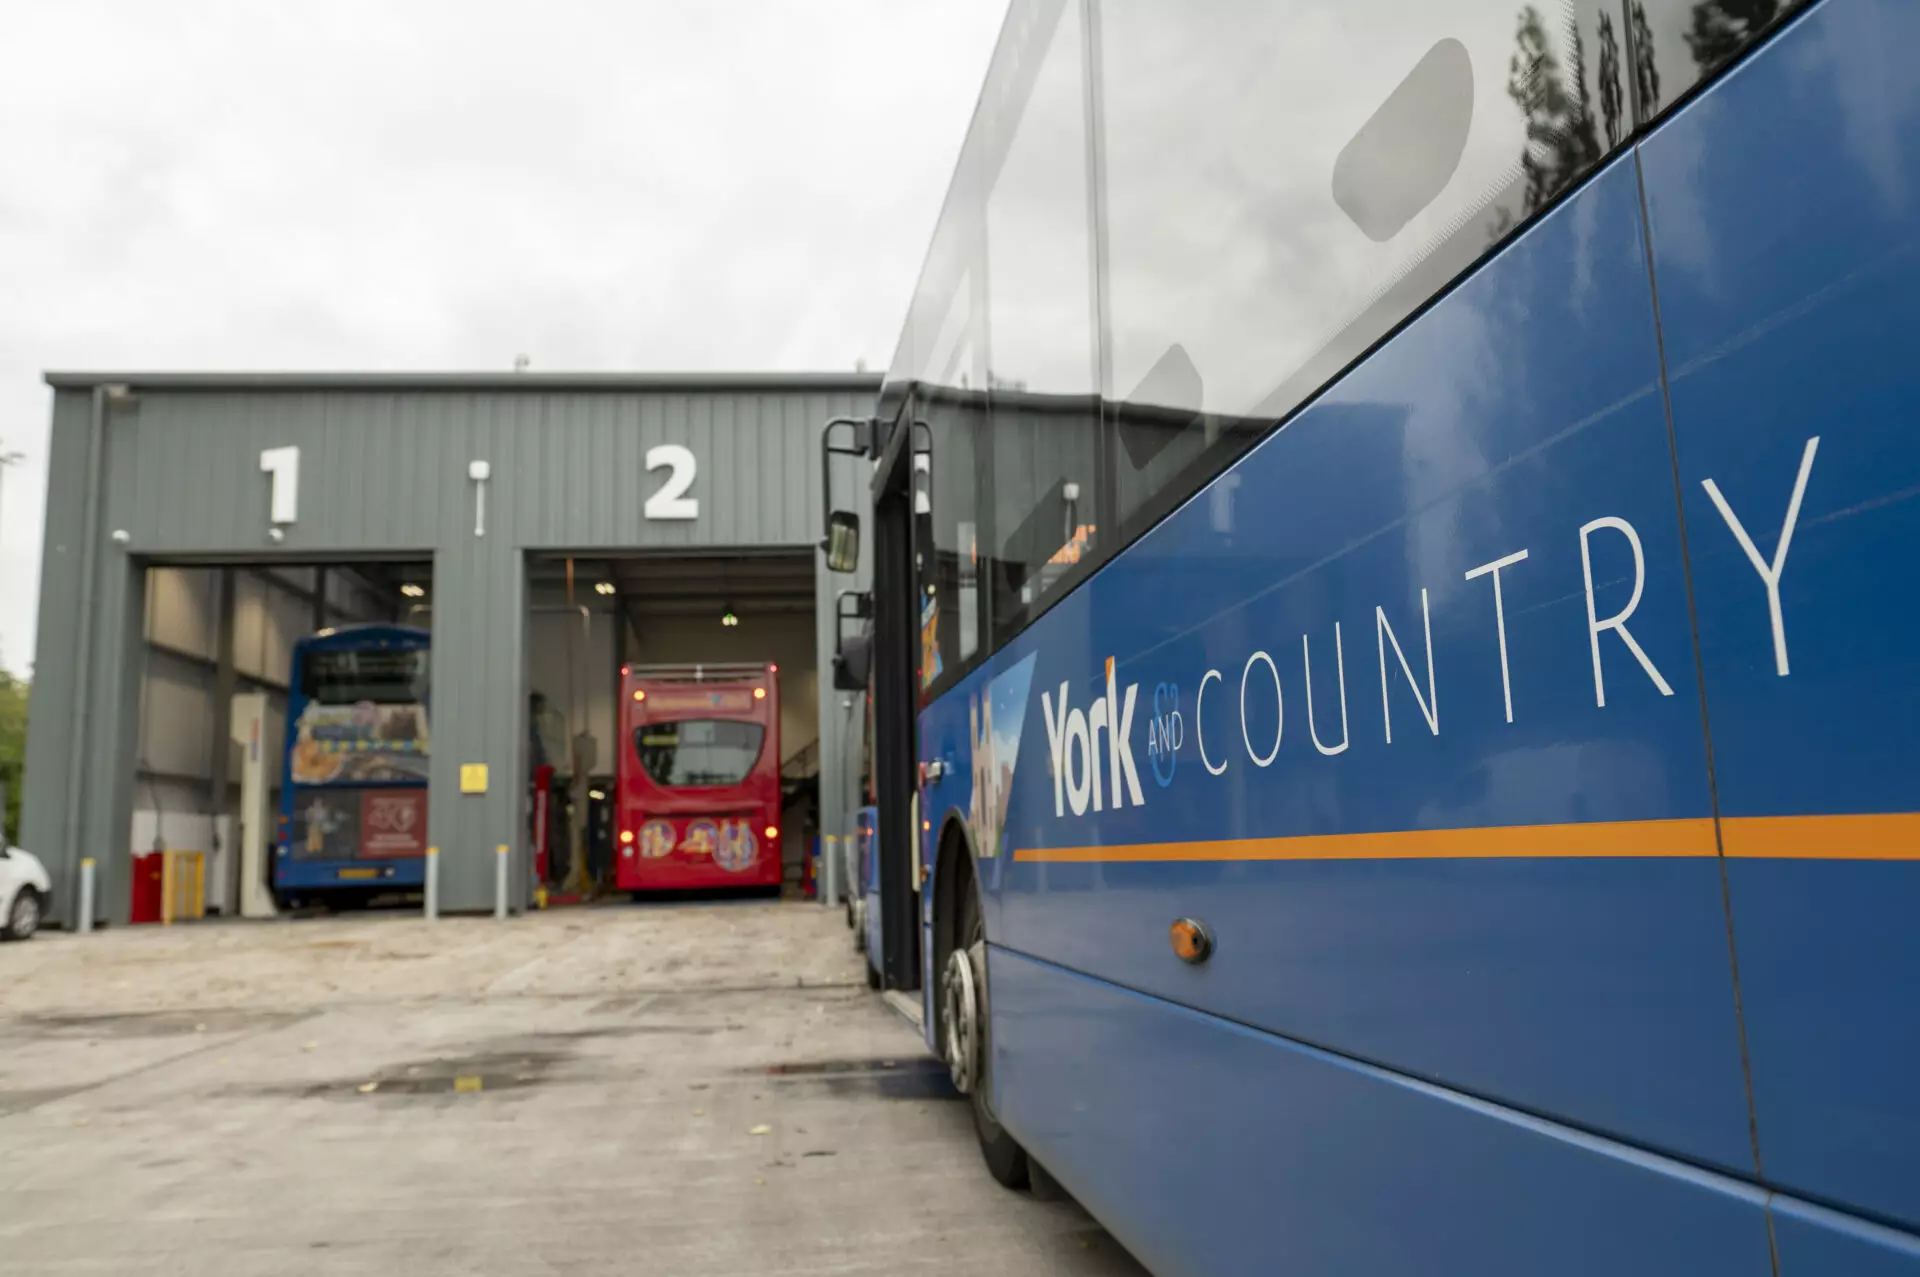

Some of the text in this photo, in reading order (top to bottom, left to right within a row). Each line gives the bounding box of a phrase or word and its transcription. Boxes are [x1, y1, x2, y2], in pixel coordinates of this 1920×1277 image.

[260, 445, 299, 522] 1
[644, 444, 698, 518] 2
[1042, 436, 1820, 817] York AND COUNTRY
